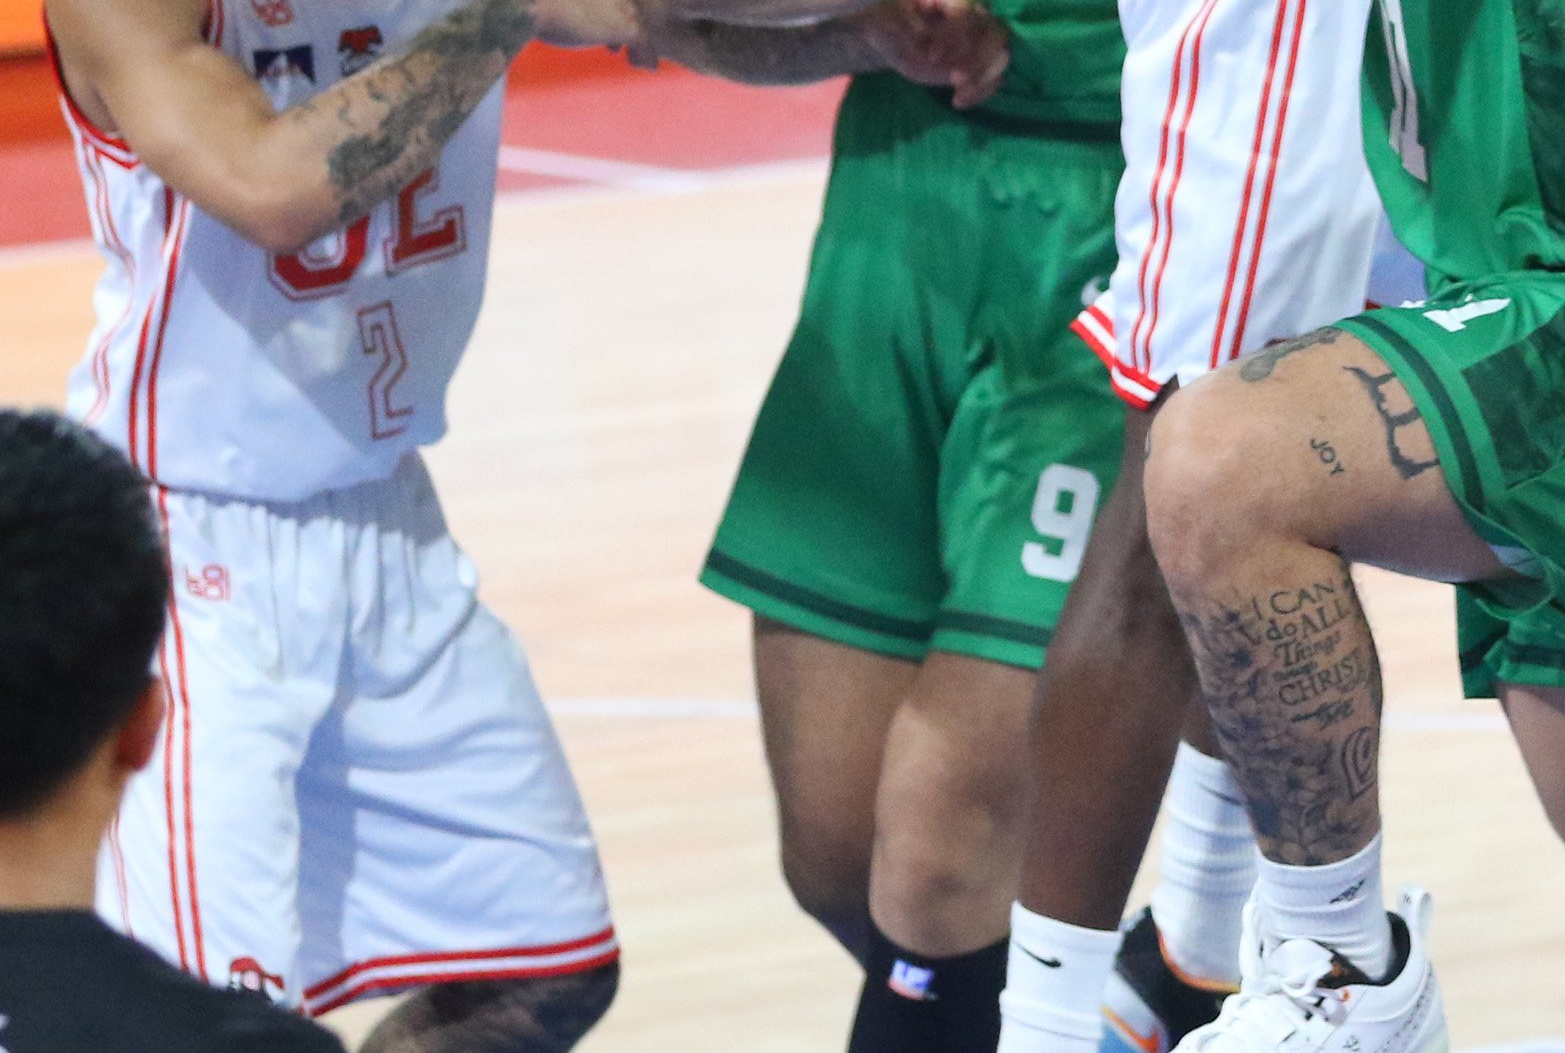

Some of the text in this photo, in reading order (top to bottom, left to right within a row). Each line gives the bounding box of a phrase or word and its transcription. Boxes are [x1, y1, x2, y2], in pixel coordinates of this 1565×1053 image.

[357, 300, 415, 441] 2
[1310, 436, 1345, 477] JOY
[1020, 462, 1101, 584] 9
[1266, 595, 1352, 641] do ALL
[1269, 578, 1340, 615] CAN
